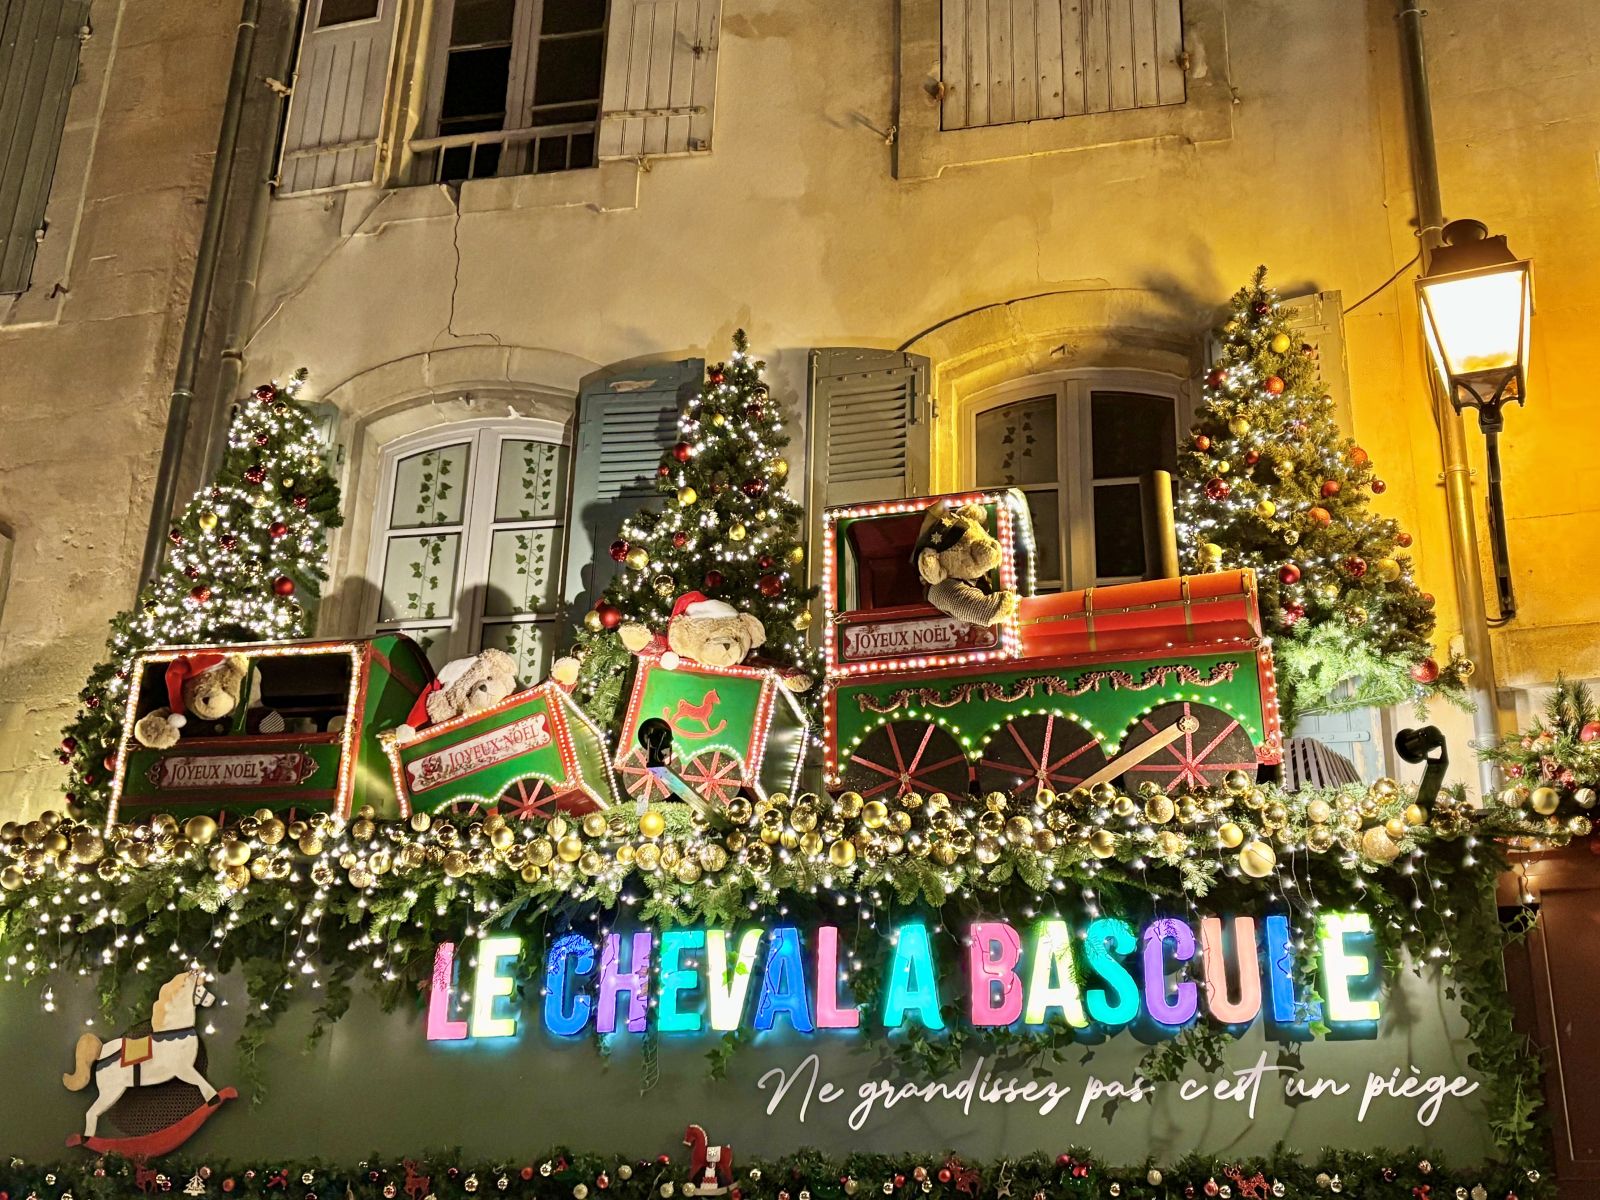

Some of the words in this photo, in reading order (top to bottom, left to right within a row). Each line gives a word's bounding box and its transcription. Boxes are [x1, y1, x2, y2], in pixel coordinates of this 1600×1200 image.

[854, 631, 908, 653] JOYEUX
[913, 624, 950, 644] NOËL
[448, 738, 501, 771] JOYEUX
[171, 763, 221, 783] JOYEUX
[223, 760, 258, 779] NOËL
[427, 937, 521, 1040] LE
[545, 926, 860, 1035] CHEVAL
[883, 923, 945, 1031] A
[970, 913, 1381, 1028] BASCULE
[758, 1054, 845, 1122] Ne
[848, 1056, 1071, 1130] grandissez
[1075, 1075, 1156, 1125] pas
[1285, 1077, 1350, 1101] un
[1357, 1065, 1480, 1127] piège
